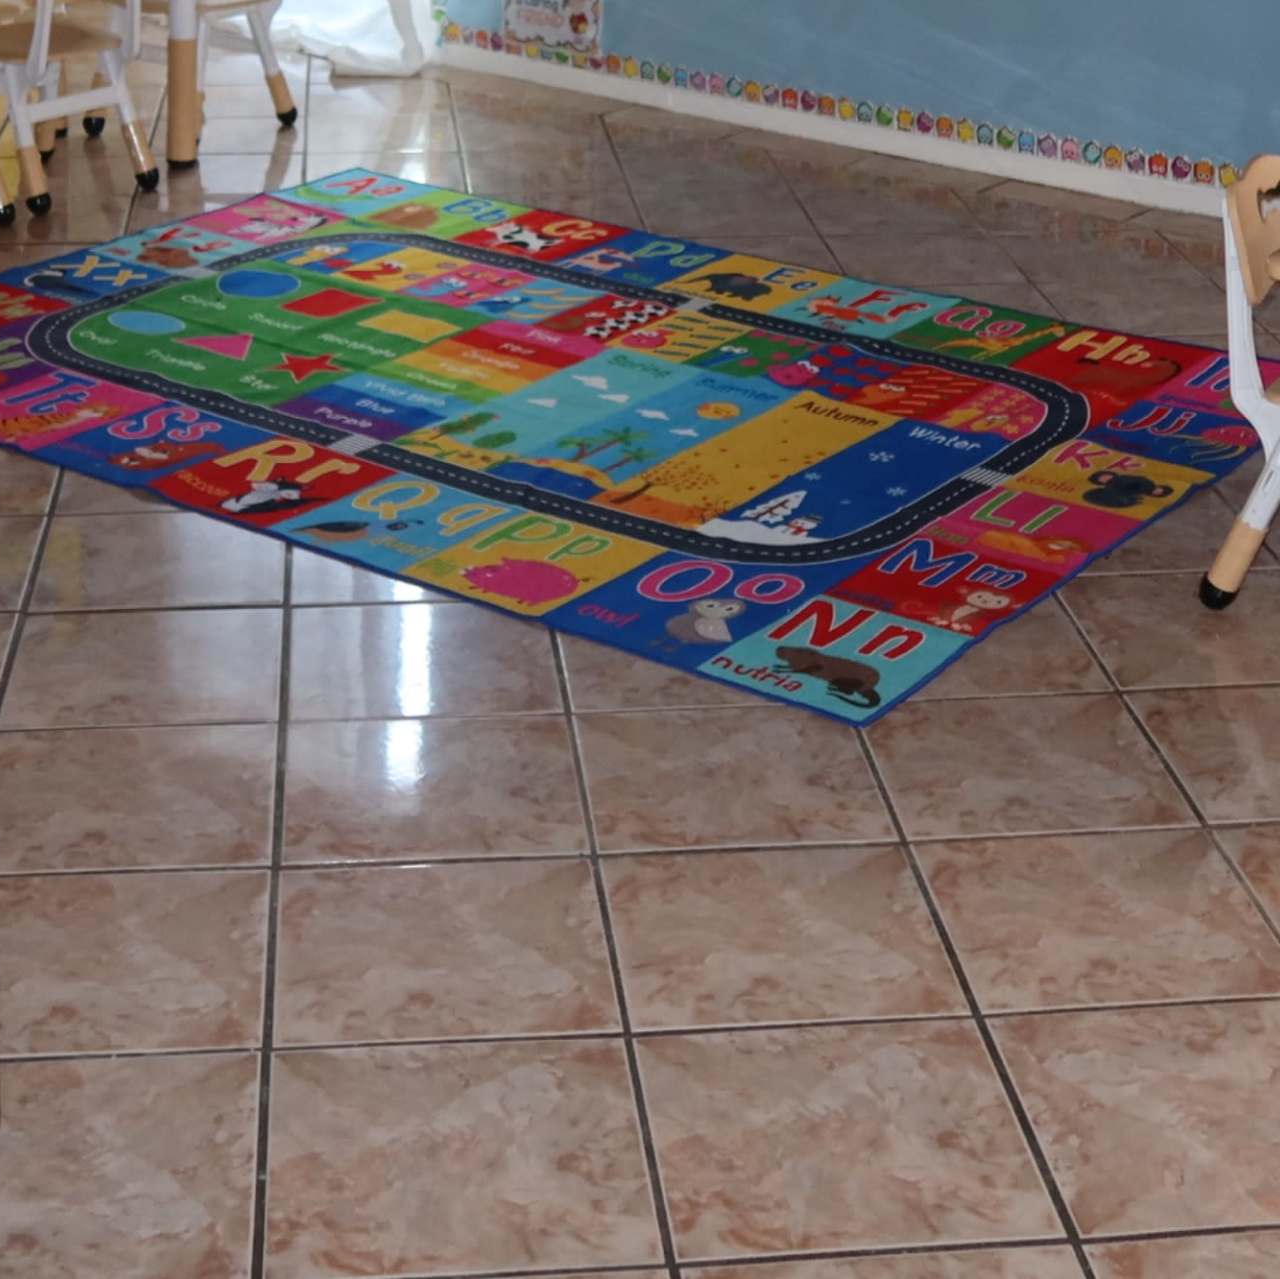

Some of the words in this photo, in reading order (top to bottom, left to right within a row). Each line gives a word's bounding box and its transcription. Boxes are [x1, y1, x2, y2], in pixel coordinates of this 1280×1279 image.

[3, 370, 98, 415] Tt
[794, 401, 879, 428] Autumn
[107, 405, 222, 442] Ss
[907, 426, 982, 453] Winter
[213, 438, 360, 484] Rr
[472, 514, 613, 562] Pp
[636, 559, 806, 605] Oo
[877, 537, 1028, 590] Mm
[766, 593, 927, 661] Nn
[710, 655, 804, 693] nutria
